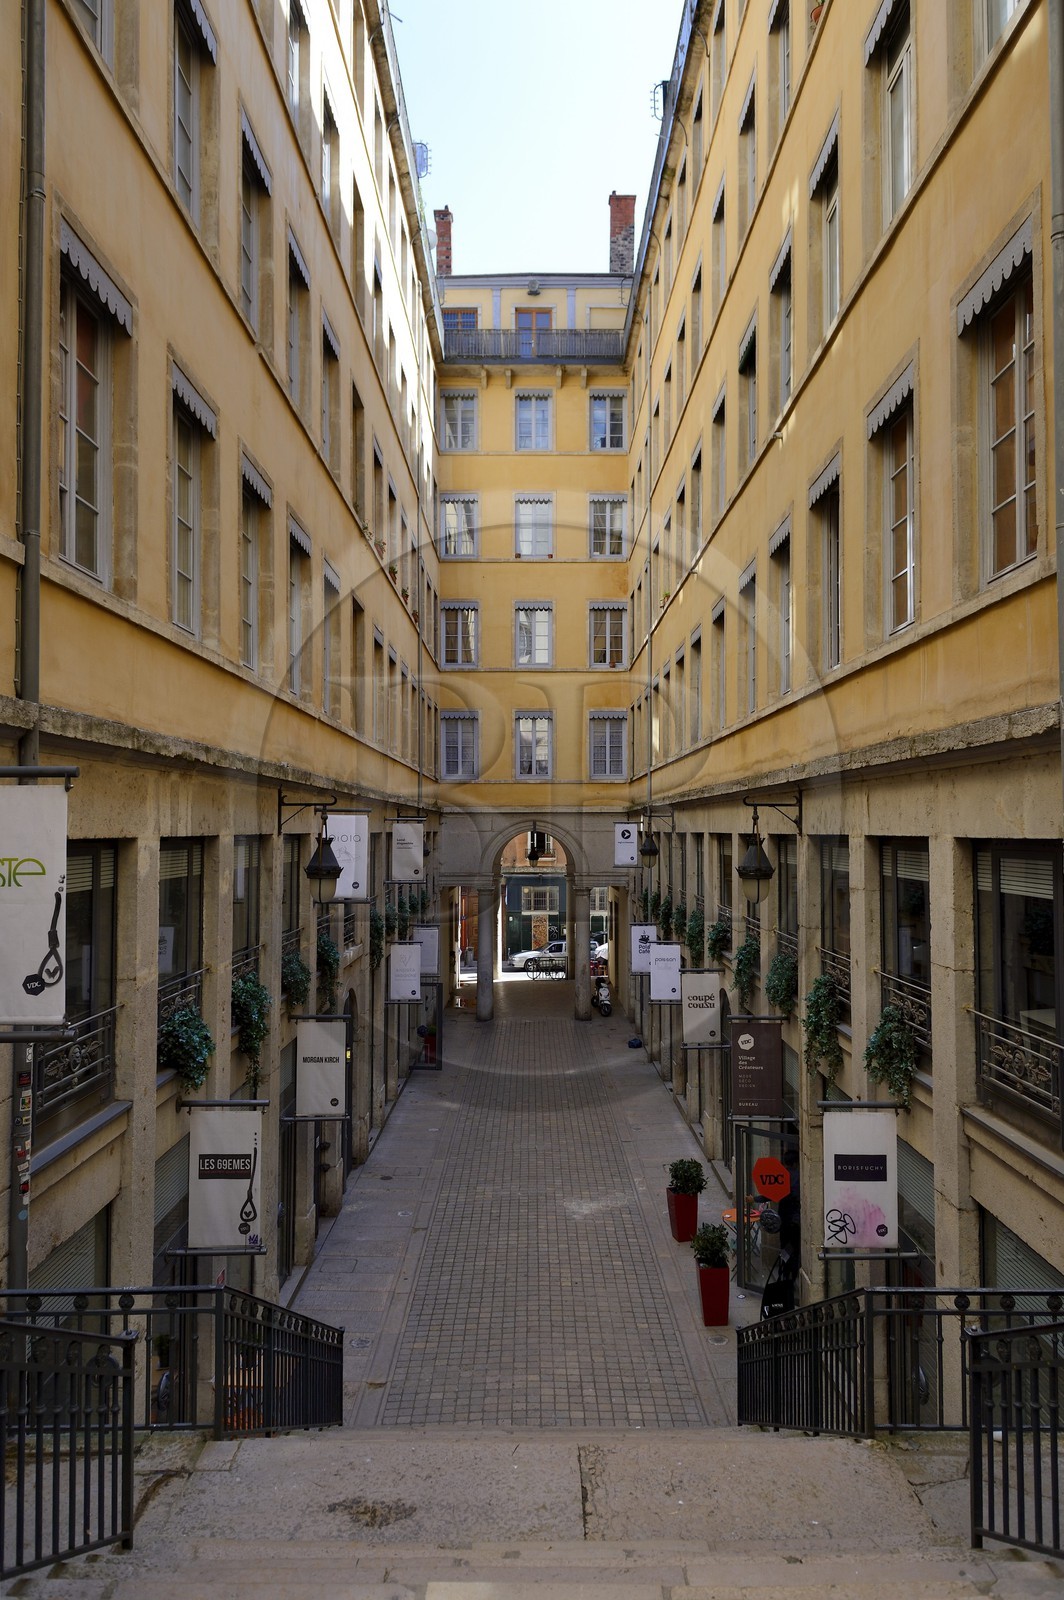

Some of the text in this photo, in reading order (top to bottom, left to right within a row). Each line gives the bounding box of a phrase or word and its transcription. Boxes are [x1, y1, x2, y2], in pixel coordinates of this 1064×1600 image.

[688, 993, 715, 1003] coupé
[200, 1159, 215, 1170] LES
[760, 1174, 785, 1186] VDC
